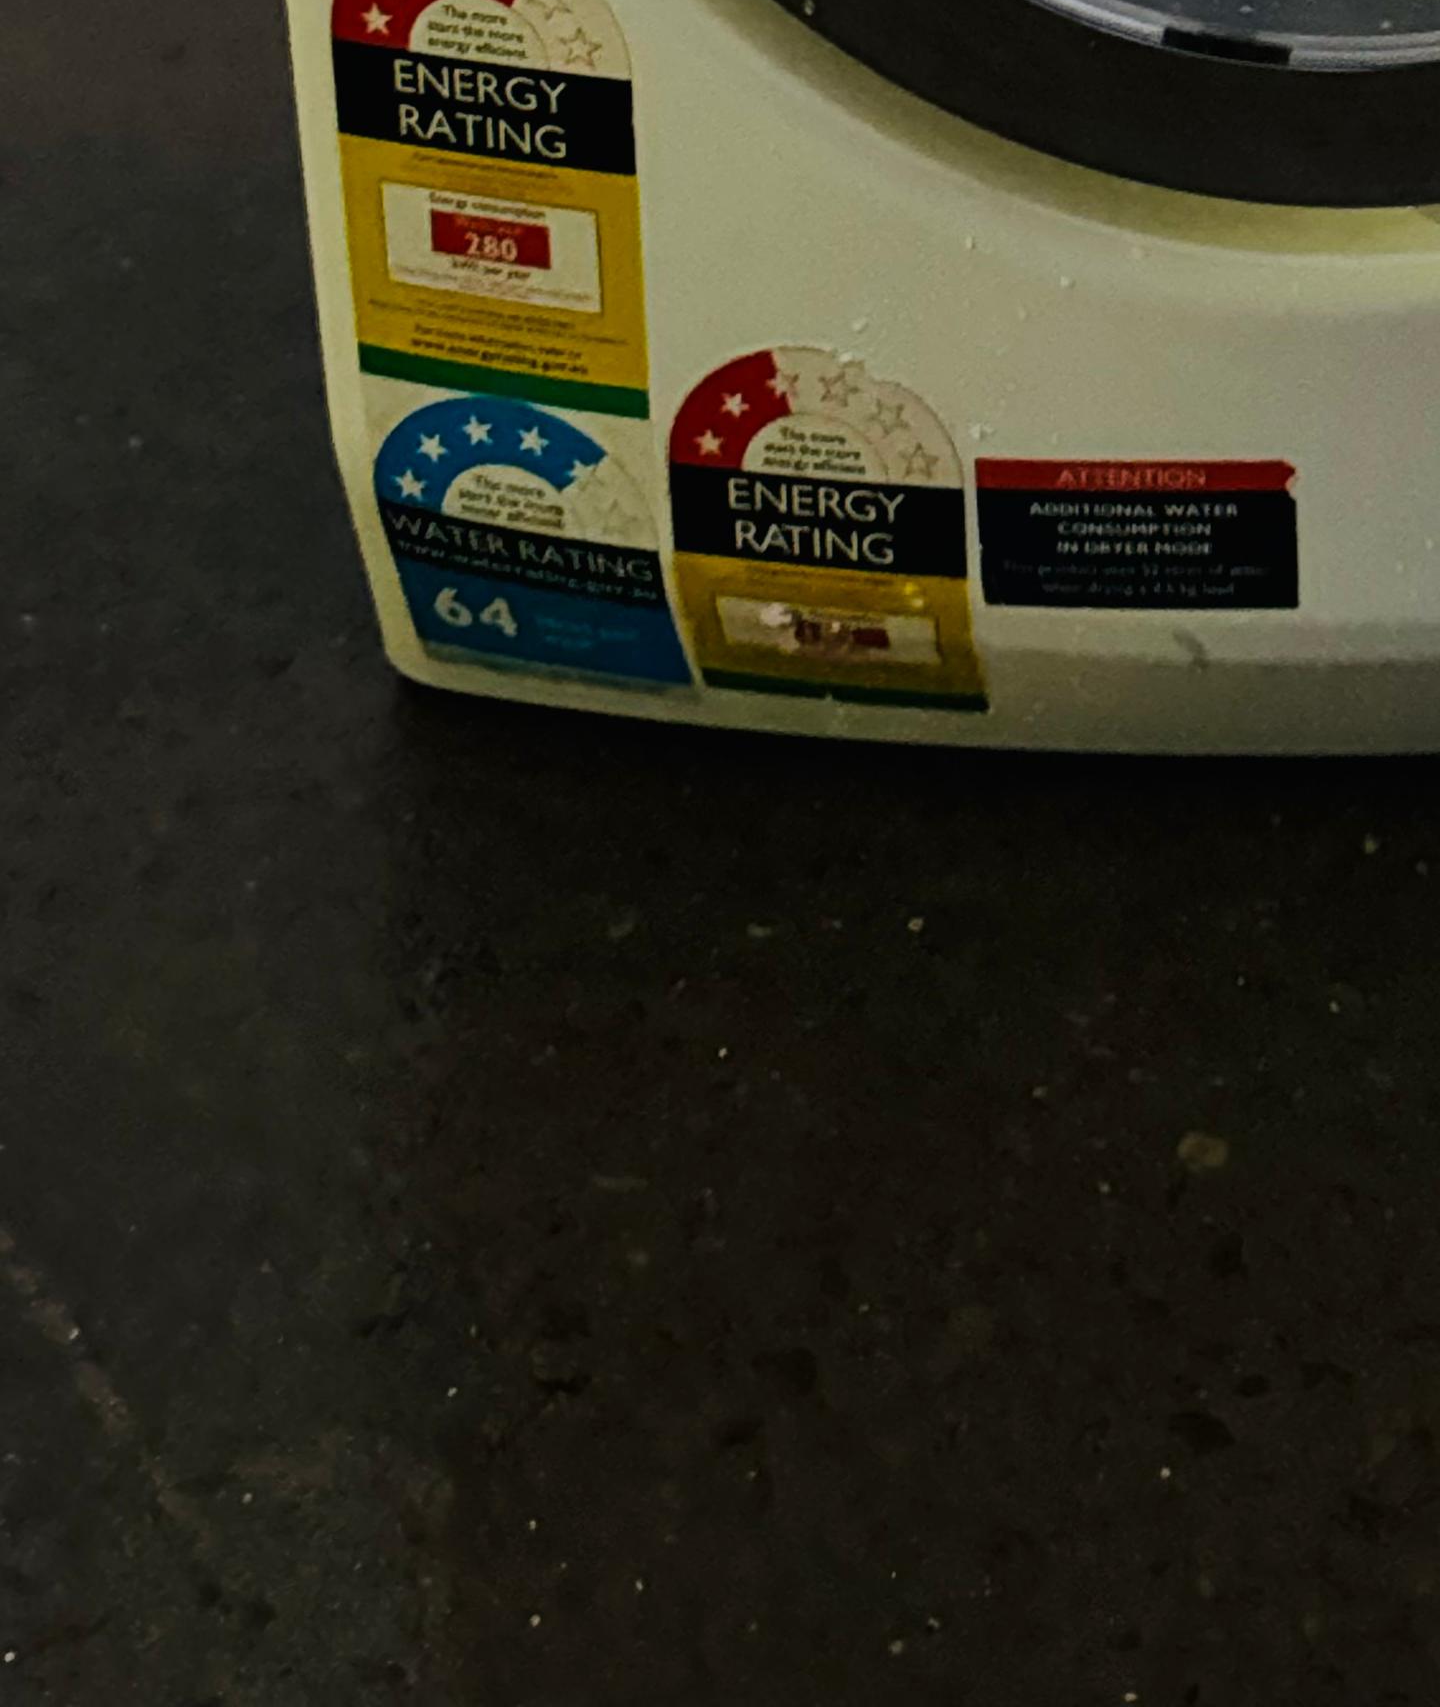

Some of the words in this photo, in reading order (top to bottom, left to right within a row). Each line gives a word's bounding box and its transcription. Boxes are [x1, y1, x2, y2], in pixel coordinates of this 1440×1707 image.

[393, 58, 568, 114] ENERGY
[398, 102, 568, 159] RATING
[464, 232, 519, 263] 280
[727, 476, 907, 524] ENERGY
[1055, 467, 1207, 488] ATTENTION
[1029, 501, 1157, 517] ADDITIONAL
[1164, 502, 1239, 517] WATER
[1056, 521, 1212, 537] CONSUMPTION
[387, 510, 511, 559] WATER
[518, 539, 654, 583] RATING
[734, 518, 896, 566] RATING
